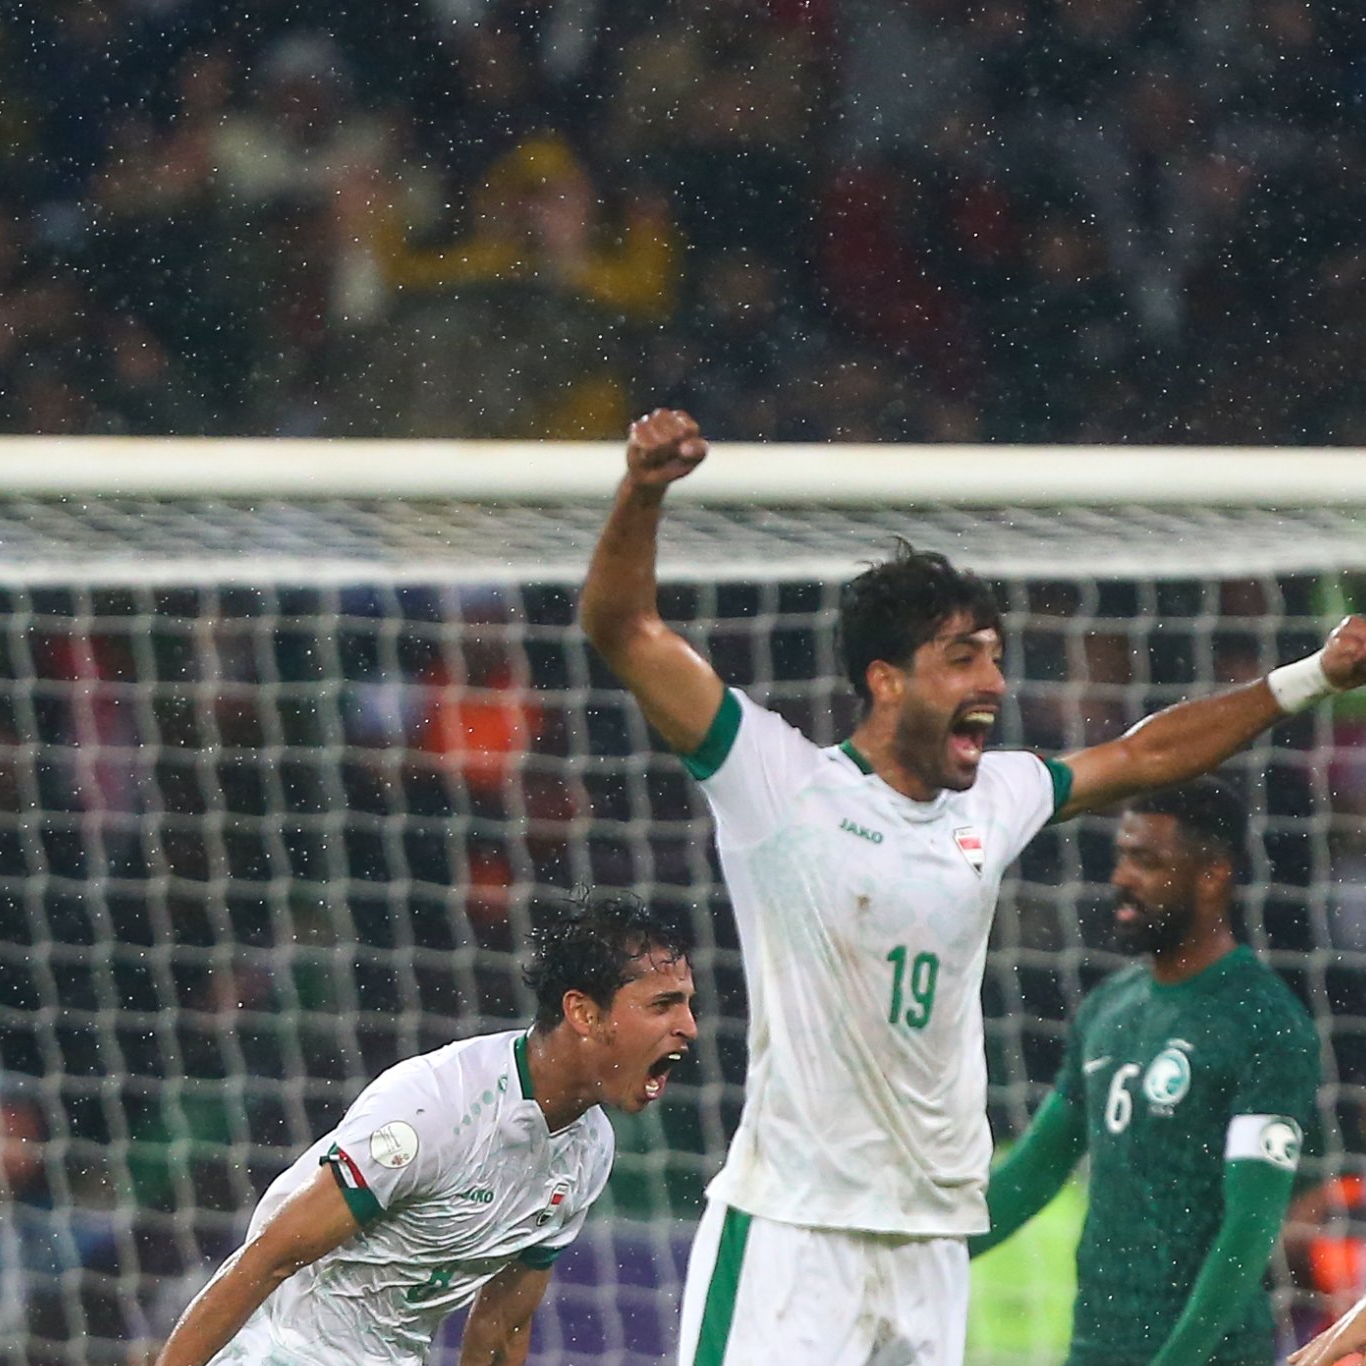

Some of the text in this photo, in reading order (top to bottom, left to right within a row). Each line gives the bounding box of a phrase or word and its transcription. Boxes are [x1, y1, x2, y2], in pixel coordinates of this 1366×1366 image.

[840, 818, 883, 843] JAKO
[886, 945, 939, 1029] 19
[1106, 1062, 1140, 1133] 6
